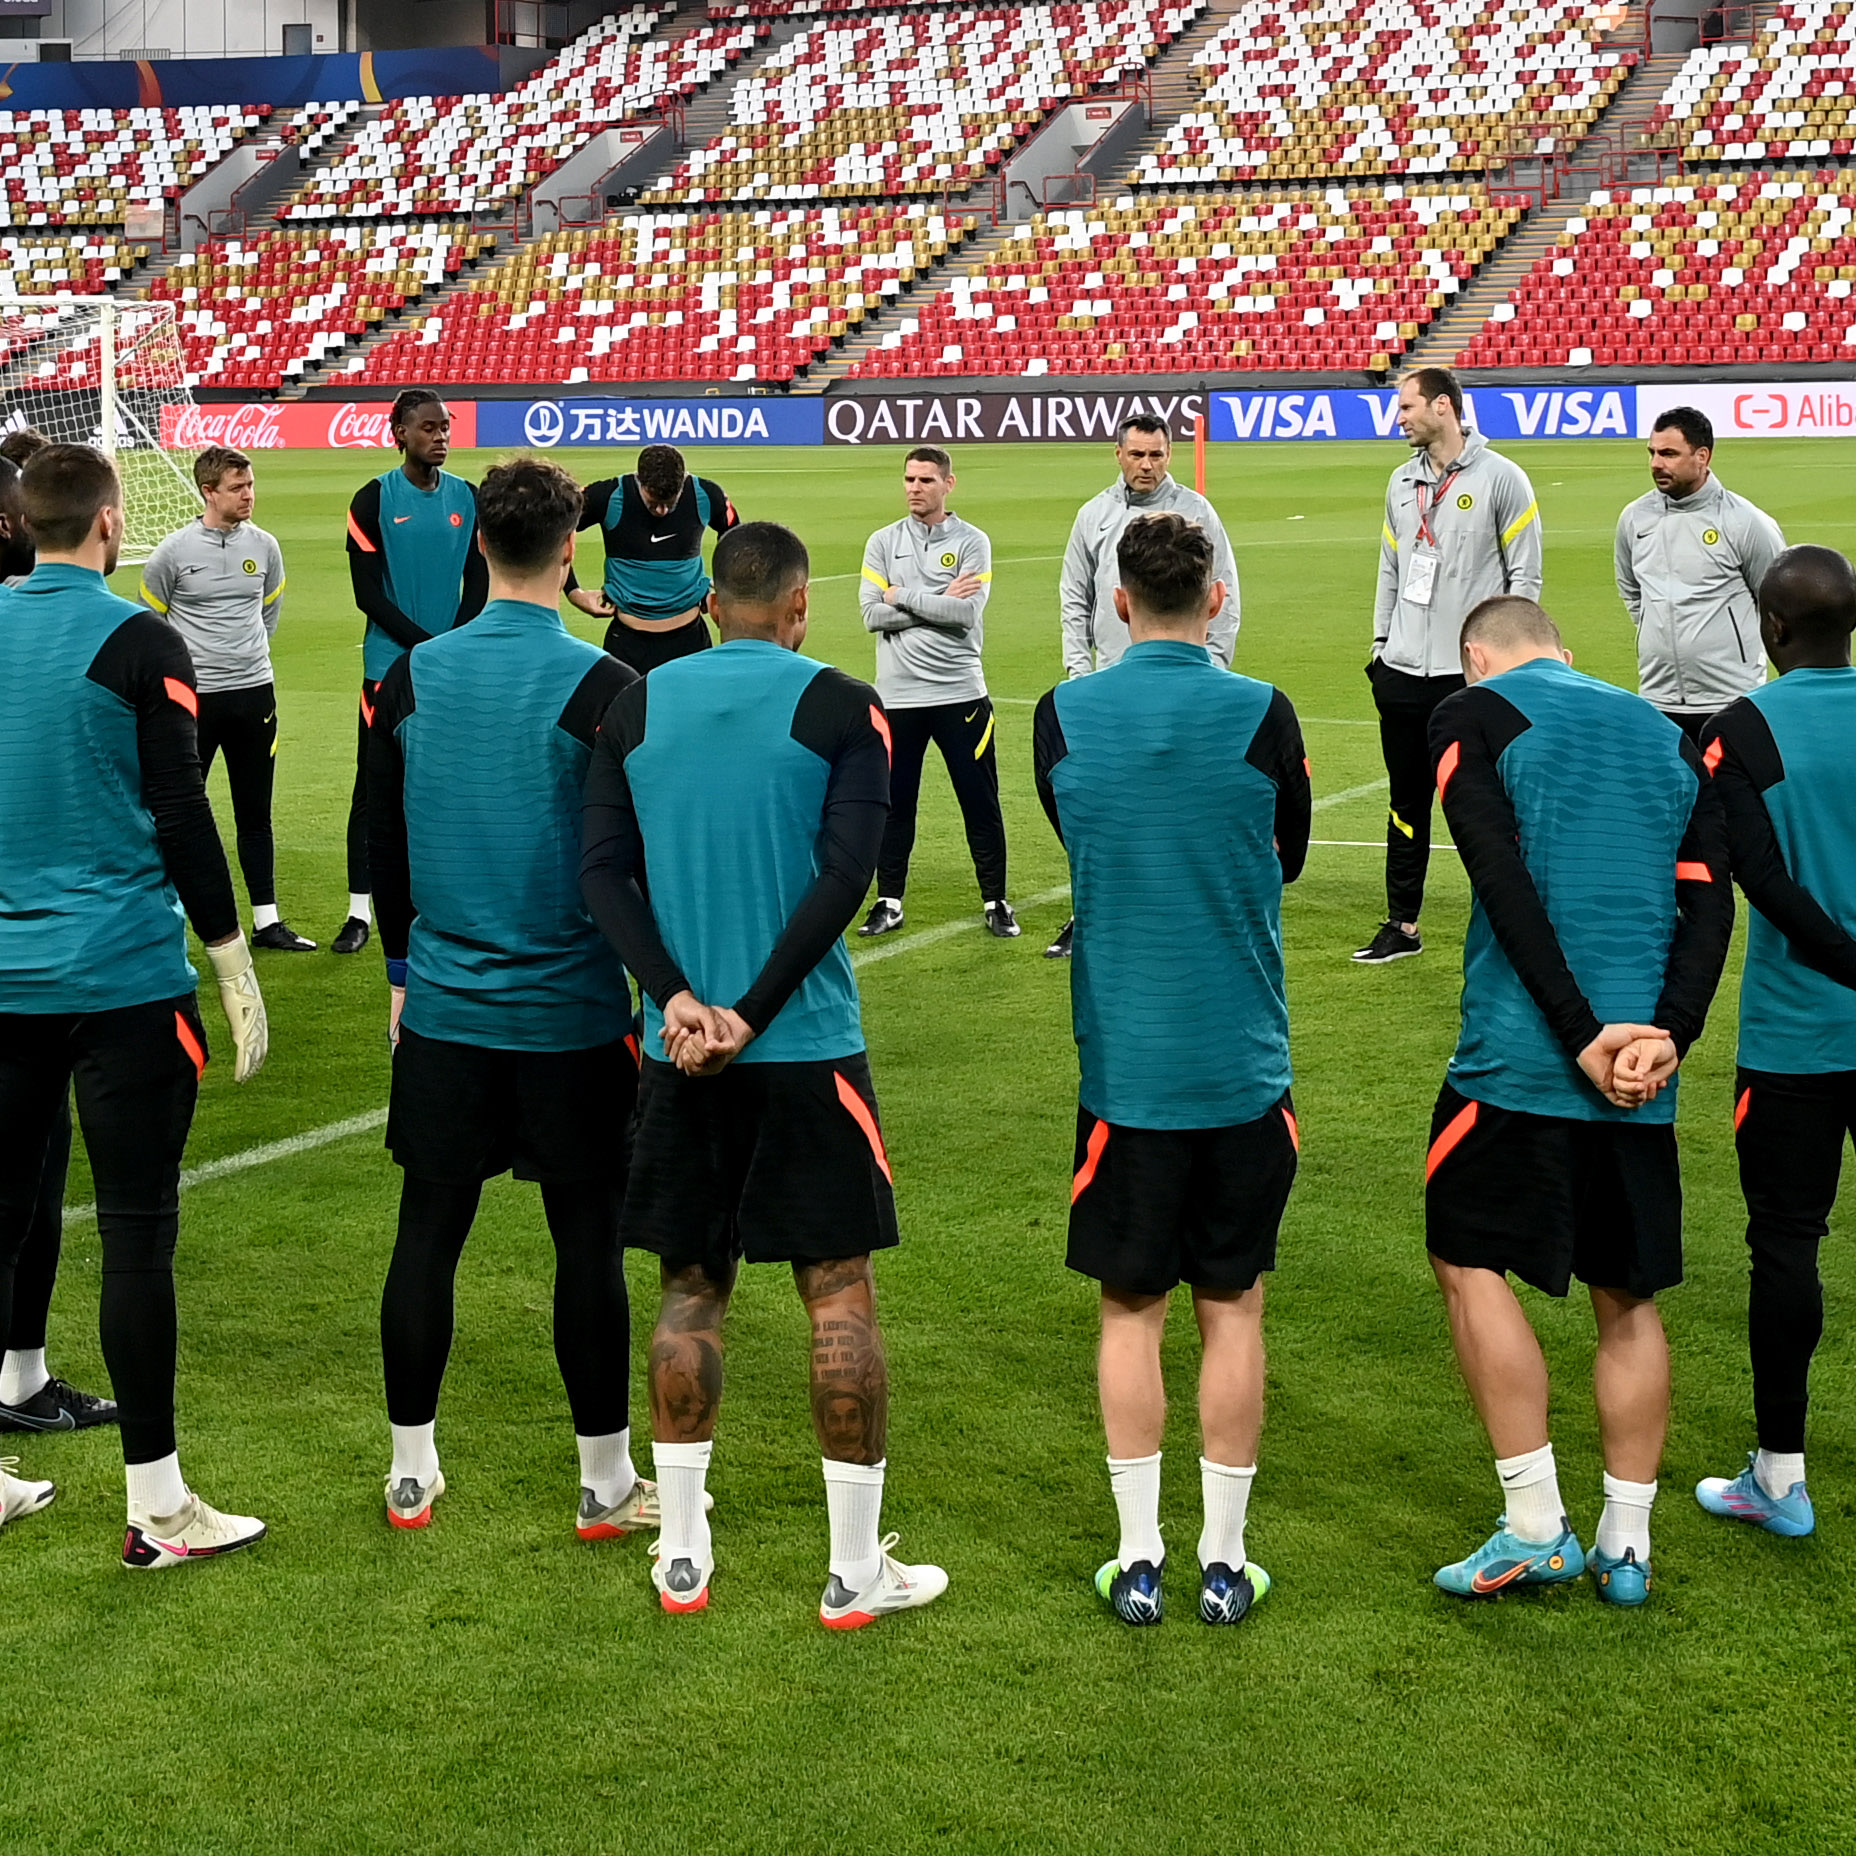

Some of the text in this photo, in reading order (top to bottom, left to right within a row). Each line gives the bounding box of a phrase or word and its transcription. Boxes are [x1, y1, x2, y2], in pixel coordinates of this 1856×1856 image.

[828, 398, 992, 444] QATAR
[1218, 395, 1338, 438] VISA
[1501, 391, 1628, 436] VISA
